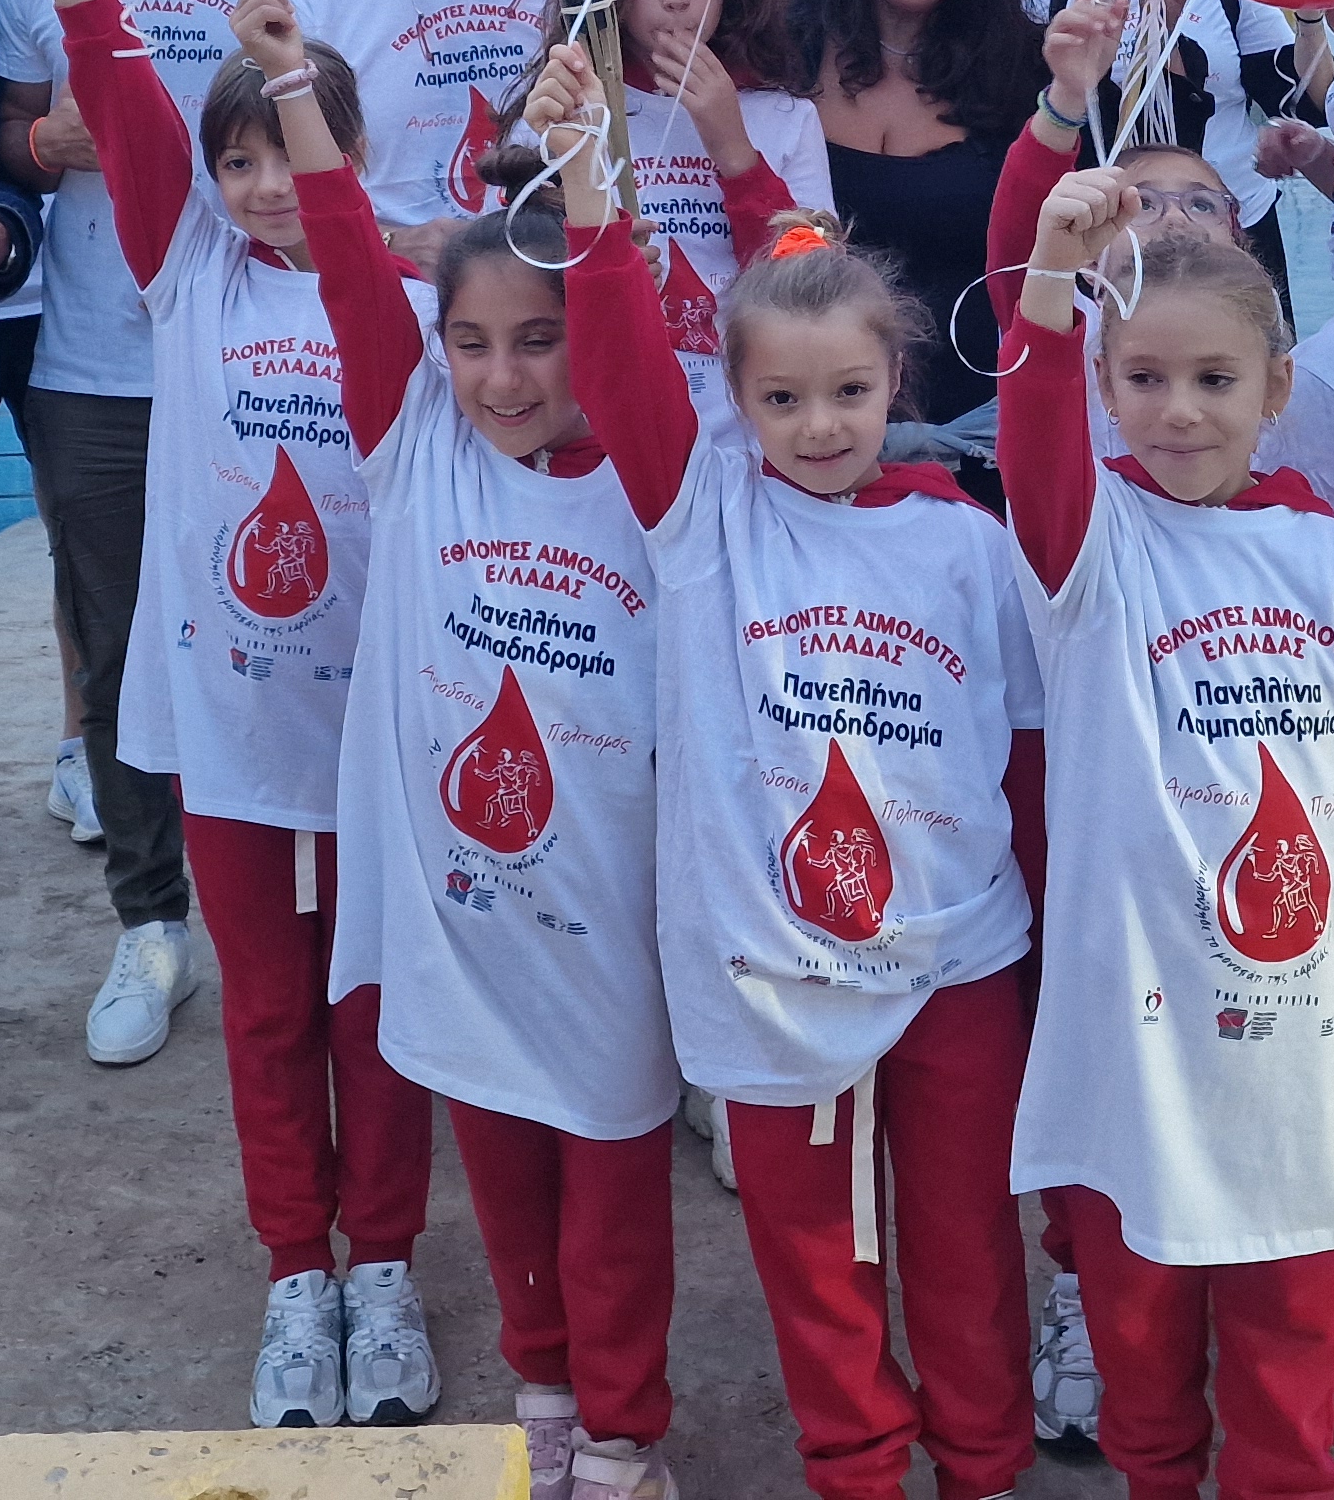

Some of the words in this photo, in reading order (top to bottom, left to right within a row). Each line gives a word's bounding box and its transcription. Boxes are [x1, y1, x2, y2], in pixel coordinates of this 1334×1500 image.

[134, 0, 194, 16] ΛΑΔΑΣ
[469, 4, 544, 30] ΑΙΜΟΔΟΤΕ
[435, 19, 507, 41] ΕΛΛΑΔΑΣ
[430, 44, 524, 67] Πανελλήνια
[641, 198, 726, 216] ανελλήνι
[222, 337, 296, 363] ΕΛΟΝΤΕΣ
[252, 358, 343, 384] ΕΛΛΑΔΑΣ
[236, 389, 344, 420] Πανελλήνι
[439, 538, 532, 567] ΕΘΛΟΝΤΕΣ
[536, 544, 647, 618] ΑΙΜΟΔΟΤΕΣ
[485, 564, 586, 600] ΕΛΛΑΔΑΣ
[470, 592, 597, 643] Πανελλήνια
[444, 611, 615, 678] Λαμπαδηδρομία
[742, 605, 848, 646] ΕΘΕΛΟΝΤΕΣ
[853, 609, 967, 685] ΑΙΜΟΔΟΤΕΣ
[799, 632, 907, 667] ΕΛΛΑΔΑΣ
[1149, 606, 1247, 664] ΕΘΛΟΝΤΕΣ
[1200, 633, 1306, 662] ΕΛΛΑΔΑΣ
[783, 671, 922, 713] Πανελλήνια
[1195, 677, 1321, 706] Πανελλήνια
[758, 693, 943, 749] Λαμπαδηδρομία
[881, 799, 963, 833] Πολιτισμός
